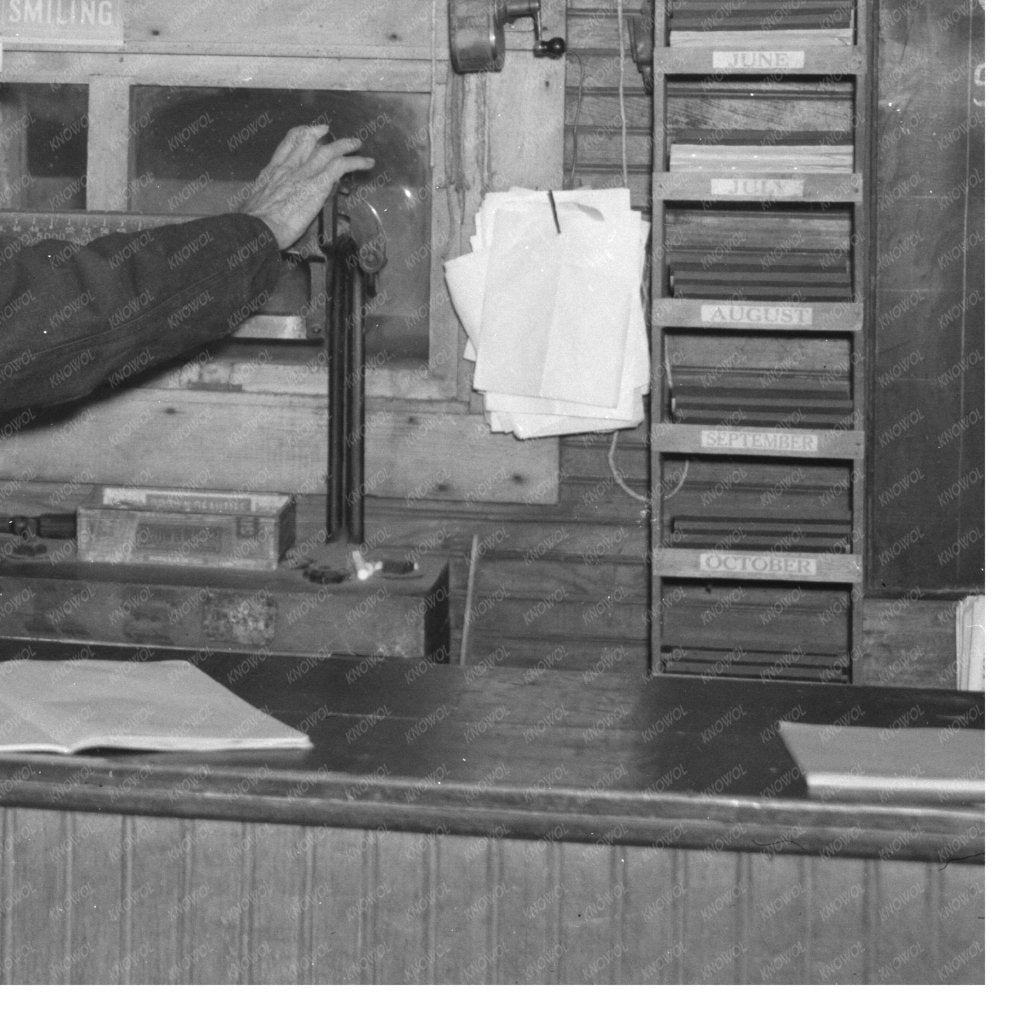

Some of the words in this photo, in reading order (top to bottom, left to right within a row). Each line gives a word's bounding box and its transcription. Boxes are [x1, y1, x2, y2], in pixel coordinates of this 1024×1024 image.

[728, 54, 790, 68] JUNE
[729, 179, 789, 194] JULY
[709, 307, 811, 323] AUGUST
[706, 431, 815, 450] SEPTEMBER
[705, 555, 812, 574] OCTOBER
